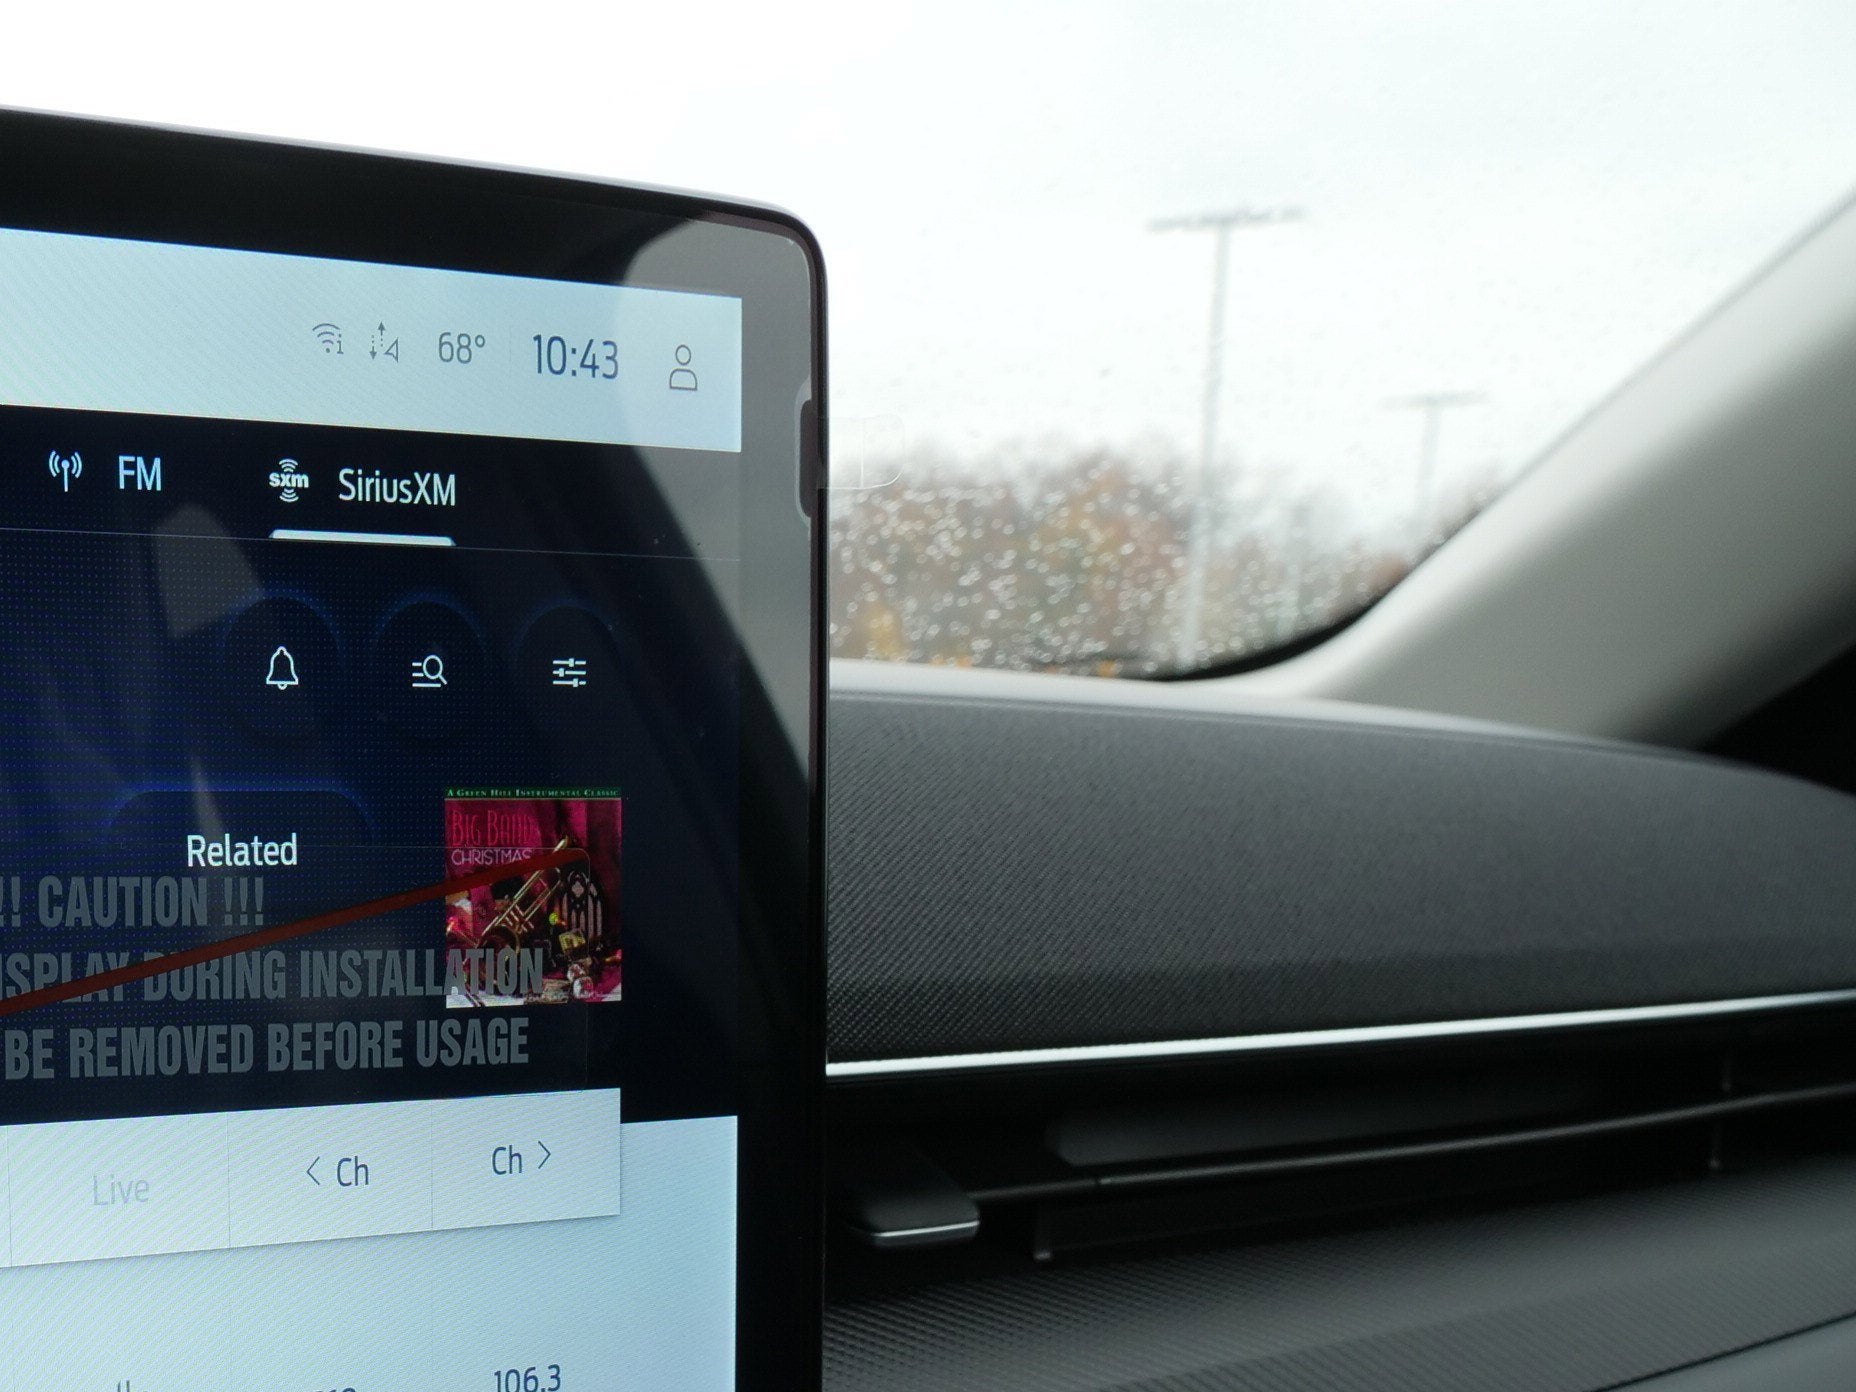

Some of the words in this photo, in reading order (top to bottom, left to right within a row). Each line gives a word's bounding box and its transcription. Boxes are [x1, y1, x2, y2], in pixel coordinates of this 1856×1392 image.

[533, 334, 619, 380] 10:43
[118, 455, 162, 491] FM
[338, 468, 456, 506] SiriusXM
[187, 832, 298, 867] Related
[38, 875, 208, 928] CAUTION
[144, 950, 286, 1001] DURING
[300, 946, 545, 999] INSTALLATION
[5, 1028, 55, 1080] BE
[69, 1023, 254, 1078] REMOVED
[267, 1019, 404, 1072] BEFORE
[416, 1017, 529, 1066] USAGE
[336, 1155, 370, 1187] Ch
[491, 1144, 523, 1175] Ch
[92, 1173, 151, 1207] Live
